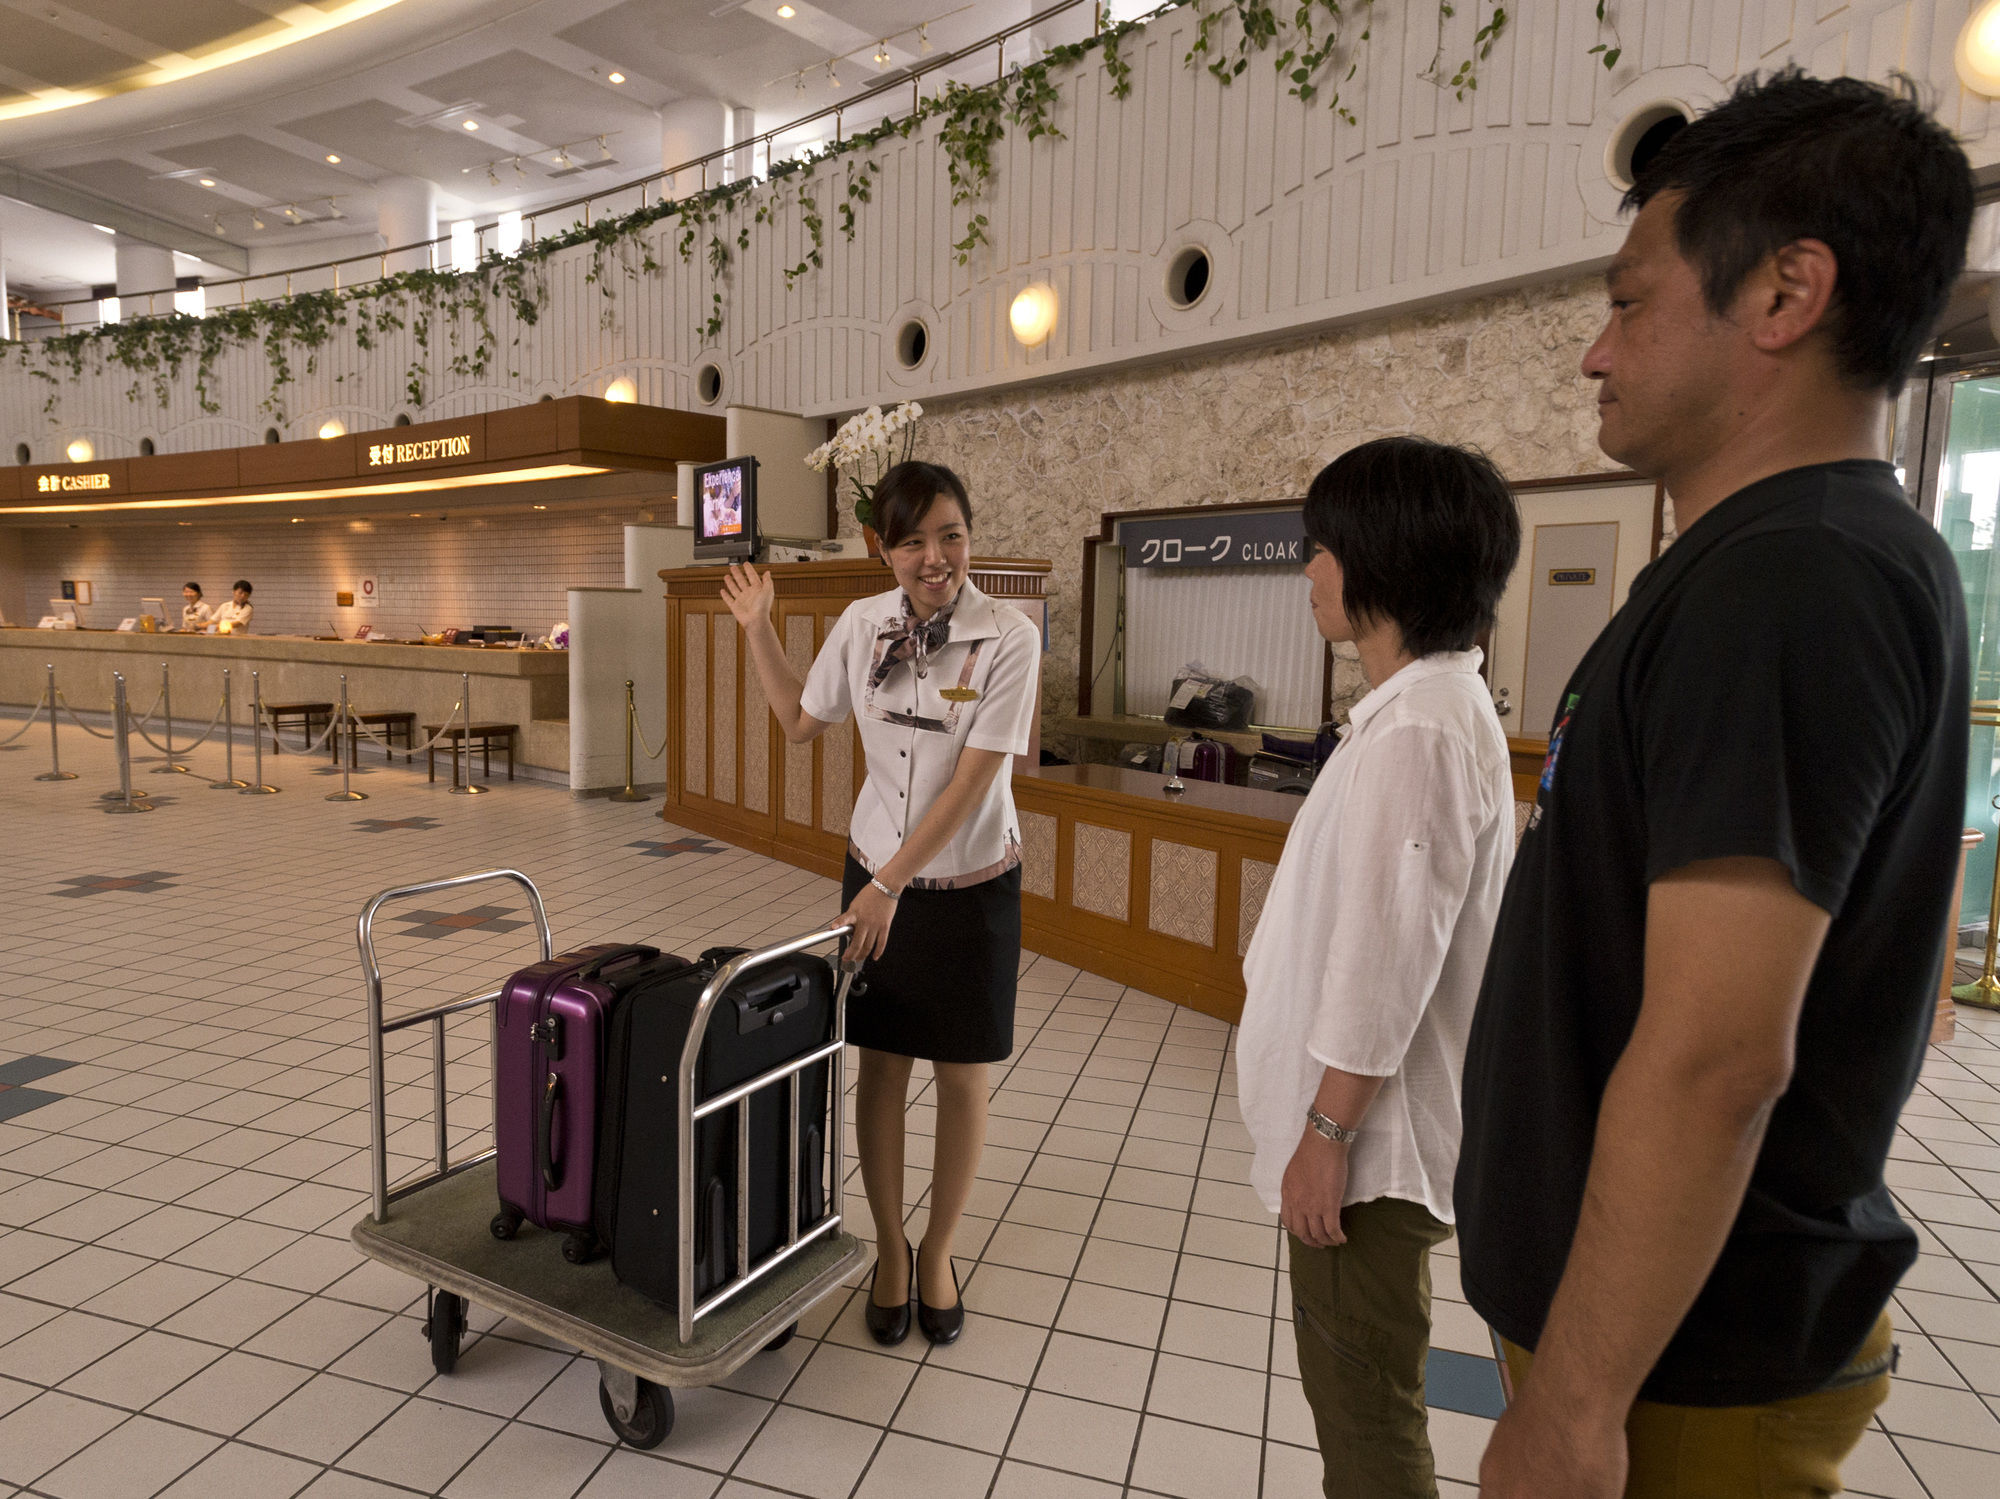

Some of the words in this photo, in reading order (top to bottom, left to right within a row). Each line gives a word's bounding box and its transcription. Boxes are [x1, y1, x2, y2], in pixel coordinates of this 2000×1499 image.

[369, 443, 395, 466] 受付
[396, 434, 471, 463] RECEPTION
[61, 473, 111, 491] CASHIER
[1140, 535, 1232, 564] クローク
[1242, 540, 1298, 561] CLOAK
